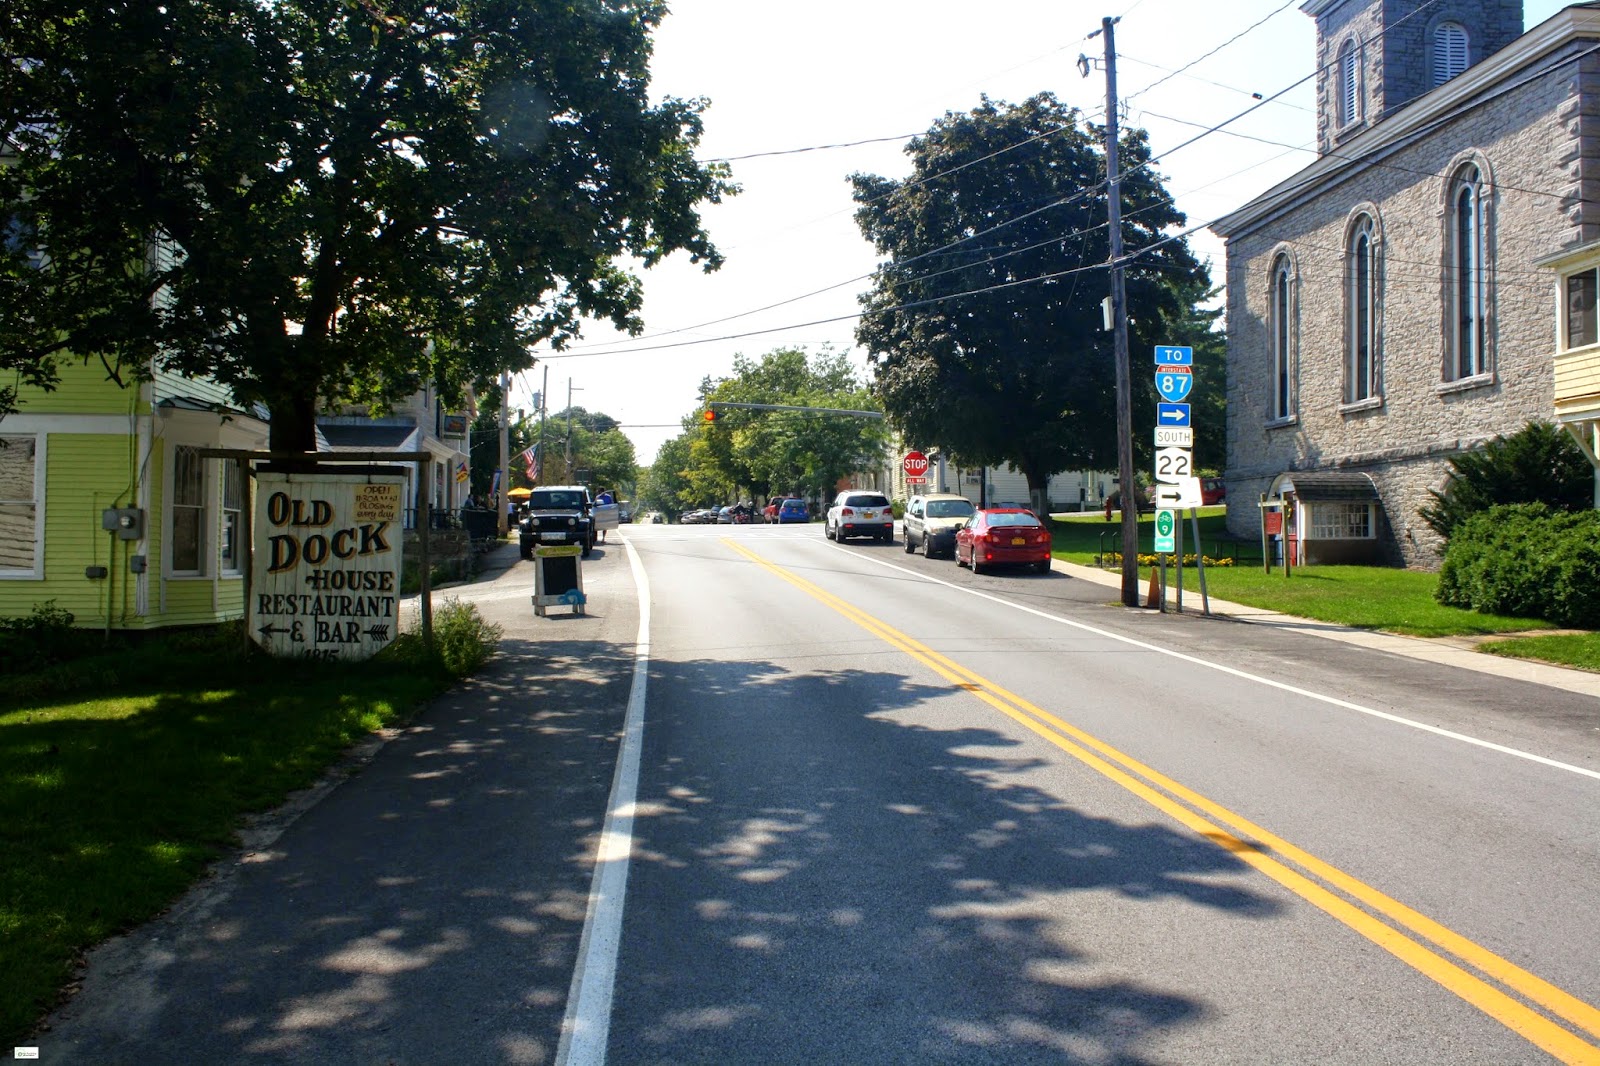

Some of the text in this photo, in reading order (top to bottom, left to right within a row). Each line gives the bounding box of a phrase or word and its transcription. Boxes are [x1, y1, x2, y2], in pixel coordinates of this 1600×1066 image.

[1164, 350, 1182, 361] TO
[1162, 375, 1188, 393] 87
[1157, 431, 1191, 442] SOUTH
[905, 459, 926, 469] STOP
[1159, 455, 1188, 475] 22
[267, 491, 335, 528] OLD
[1161, 525, 1169, 534] 9
[267, 521, 391, 574] DOCK
[308, 569, 395, 592] HOUSE
[257, 593, 395, 617] RESTAURANT
[290, 620, 361, 643] & BAR
